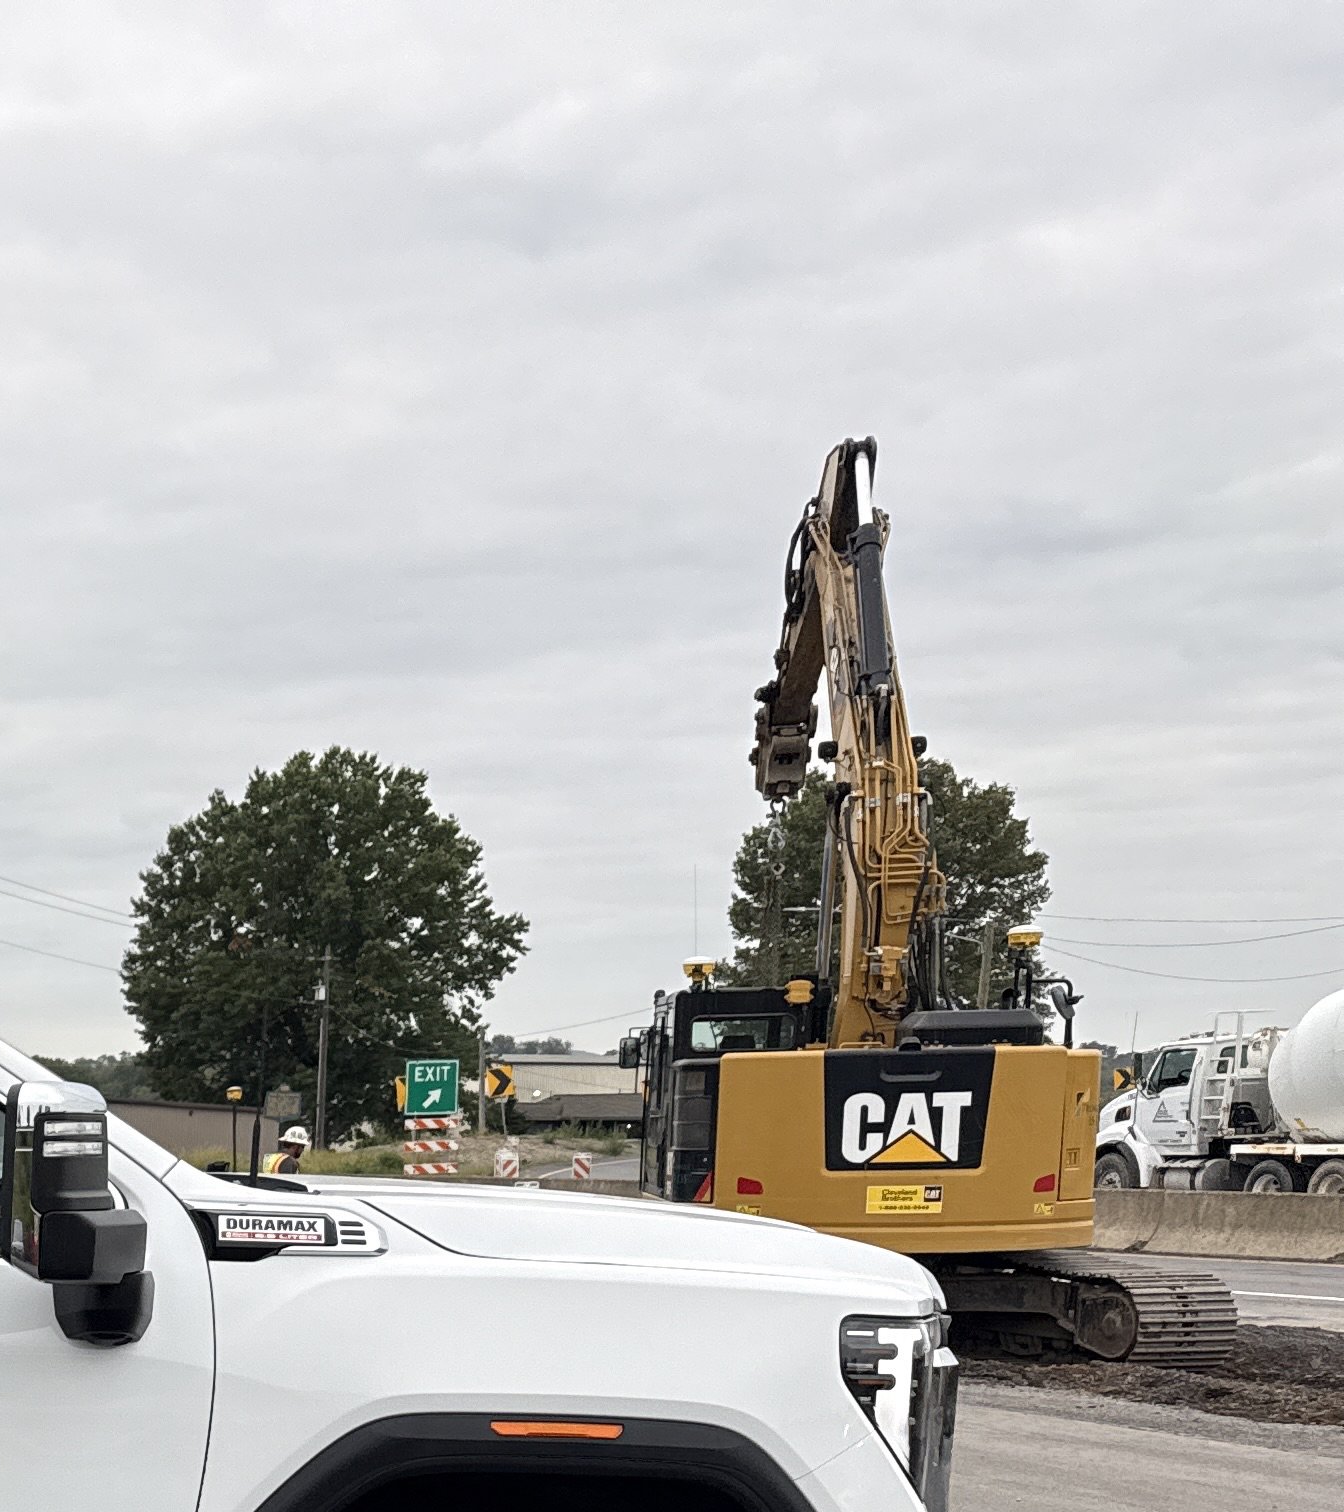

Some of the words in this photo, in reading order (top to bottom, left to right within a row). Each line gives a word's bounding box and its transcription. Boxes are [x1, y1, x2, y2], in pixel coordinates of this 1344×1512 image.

[414, 1065, 452, 1083] EXIT
[841, 1091, 973, 1164] CAT
[924, 1189, 941, 1199] CAT
[226, 1217, 318, 1232] DURAMAX
